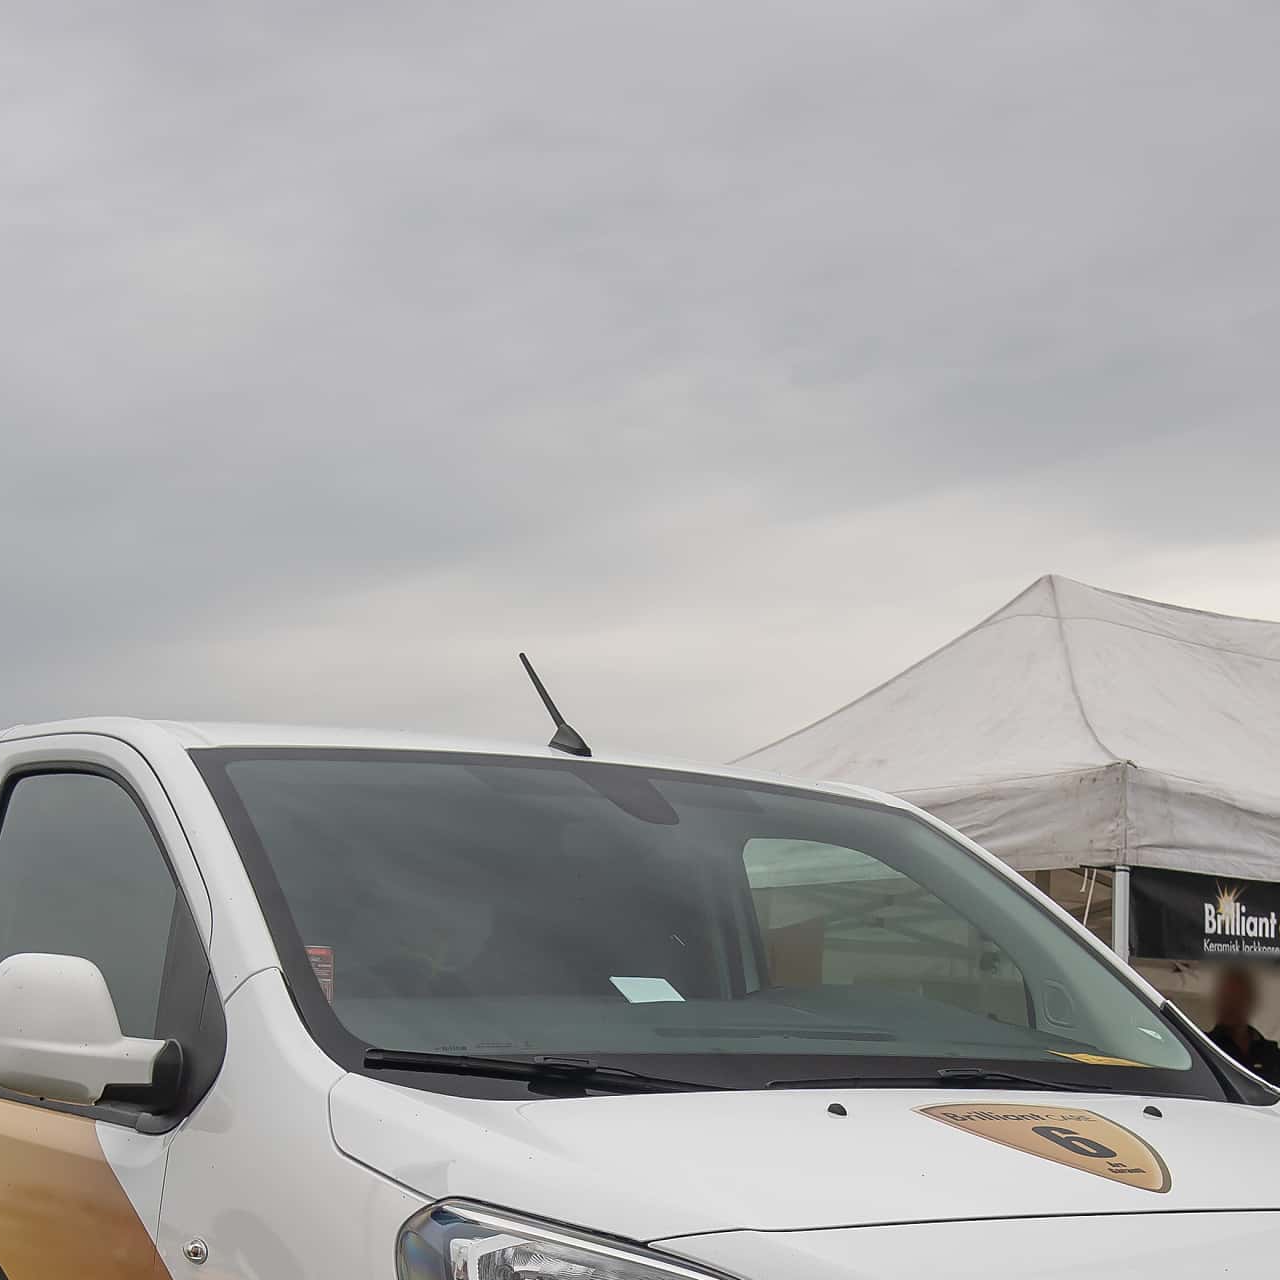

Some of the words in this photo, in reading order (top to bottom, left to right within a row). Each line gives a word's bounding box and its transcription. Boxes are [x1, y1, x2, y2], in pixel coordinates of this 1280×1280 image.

[1204, 902, 1277, 938] Brilliant
[942, 1110, 1047, 1122] Brilliant
[1032, 1125, 1117, 1158] 6
